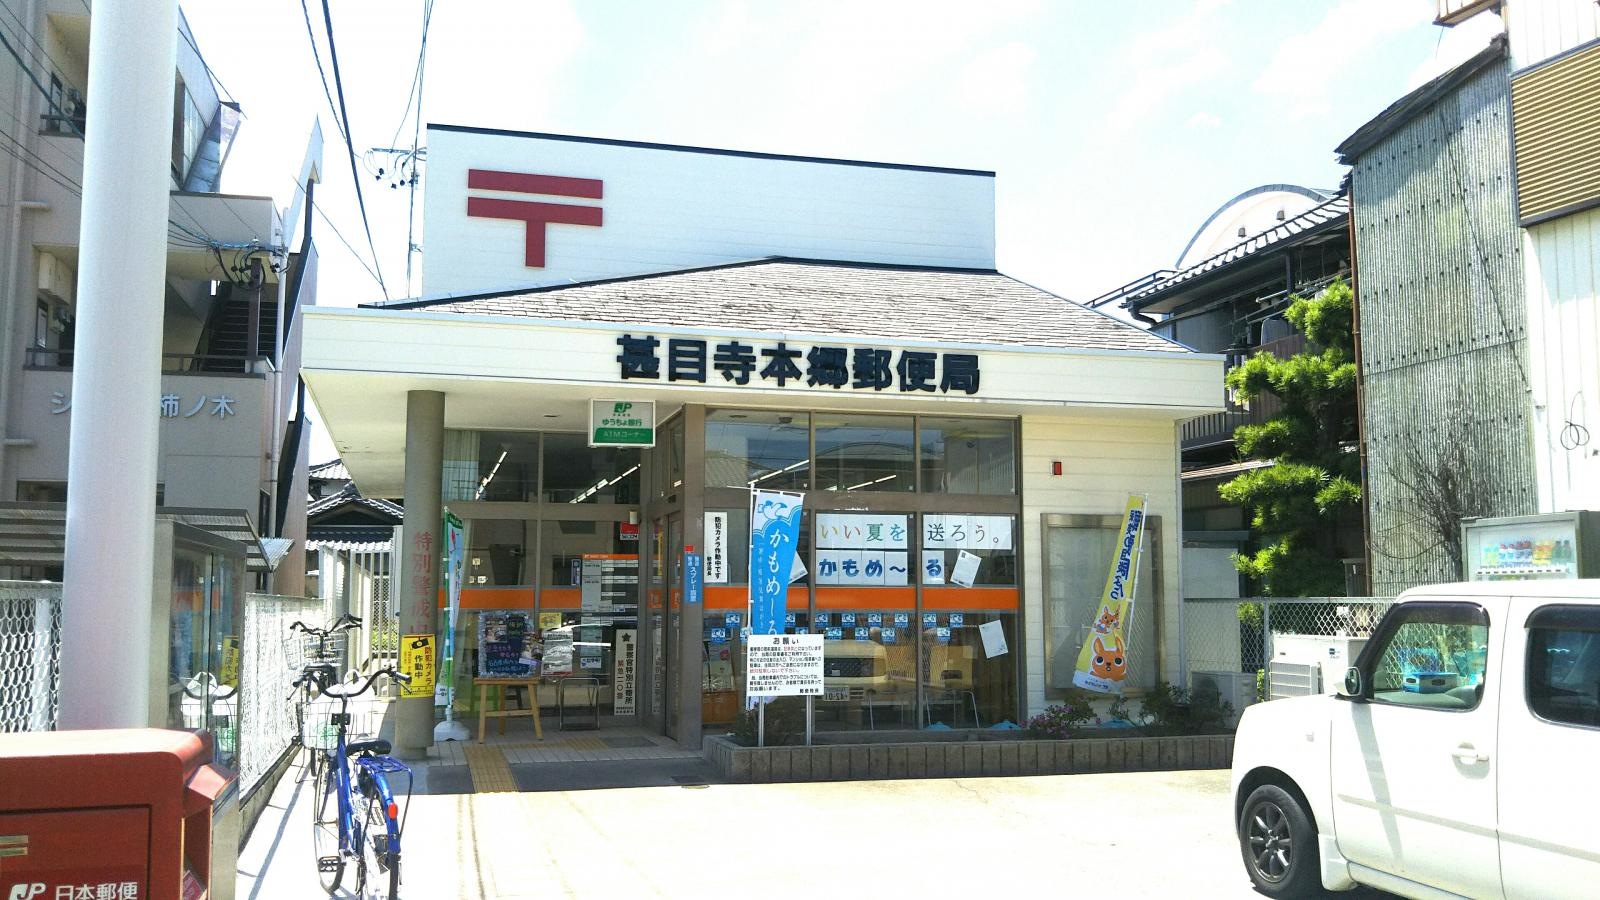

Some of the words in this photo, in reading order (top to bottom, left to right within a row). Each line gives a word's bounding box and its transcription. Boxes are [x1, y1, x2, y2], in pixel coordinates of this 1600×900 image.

[616, 334, 980, 395] 甚目寺本郷郵便局
[51, 390, 235, 419] シ柿ノ木
[602, 418, 642, 426] ゆうちょ銀行
[821, 523, 906, 542] いい夏を
[927, 523, 999, 544] 送ろう。
[773, 637, 799, 645] お願い
[414, 654, 424, 679] 作動中
[424, 646, 433, 687] 防犯カメラ
[55, 882, 138, 900] 日本郵便
